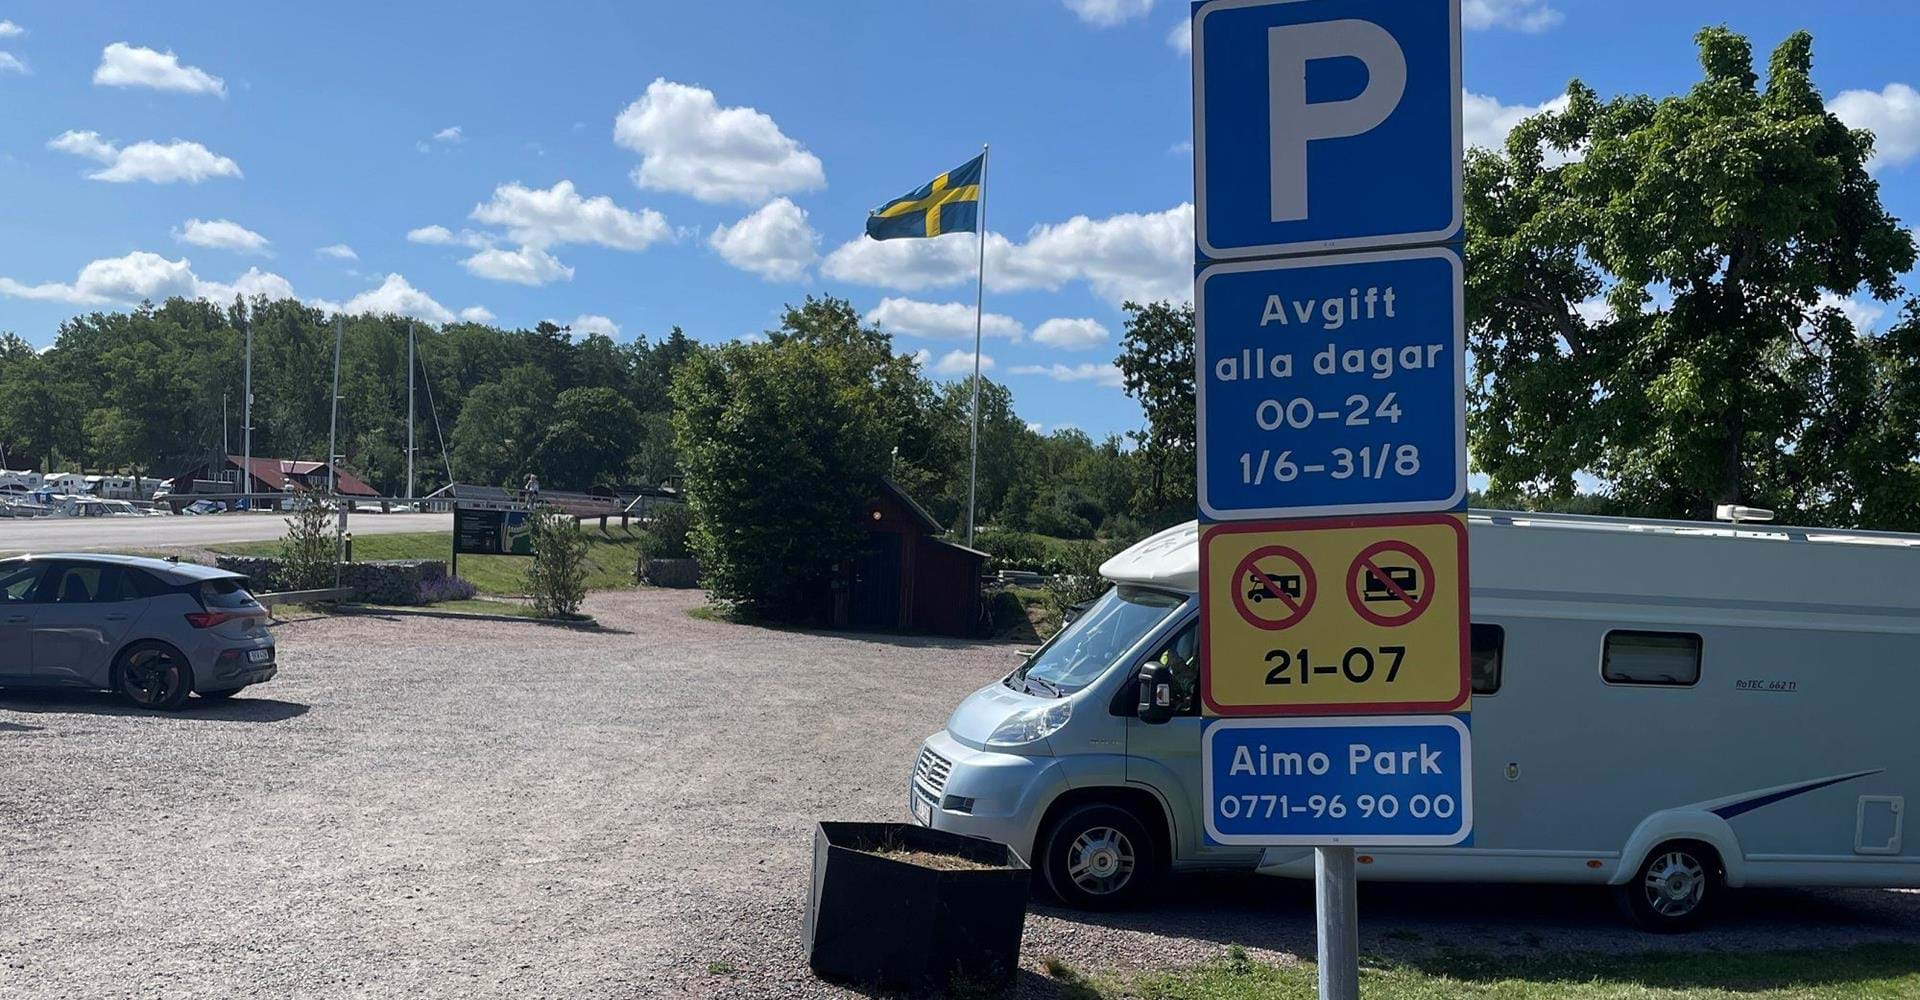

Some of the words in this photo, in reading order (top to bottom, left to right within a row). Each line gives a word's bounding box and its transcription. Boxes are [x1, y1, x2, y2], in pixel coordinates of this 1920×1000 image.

[1268, 19, 1407, 223] P
[1260, 286, 1395, 330] Avgift
[1215, 348, 1293, 381] alla
[1313, 343, 1444, 380] dagar
[1256, 392, 1402, 431] 00-24
[1239, 443, 1420, 485] 1/6-31/8
[1264, 646, 1406, 685] 21-07
[1769, 680, 1786, 690] 662
[1229, 744, 1330, 776] Aimo
[1349, 743, 1443, 775] Park
[1219, 794, 1347, 819] 0771-96
[1356, 794, 1399, 819] 90
[1408, 794, 1455, 819] 00
